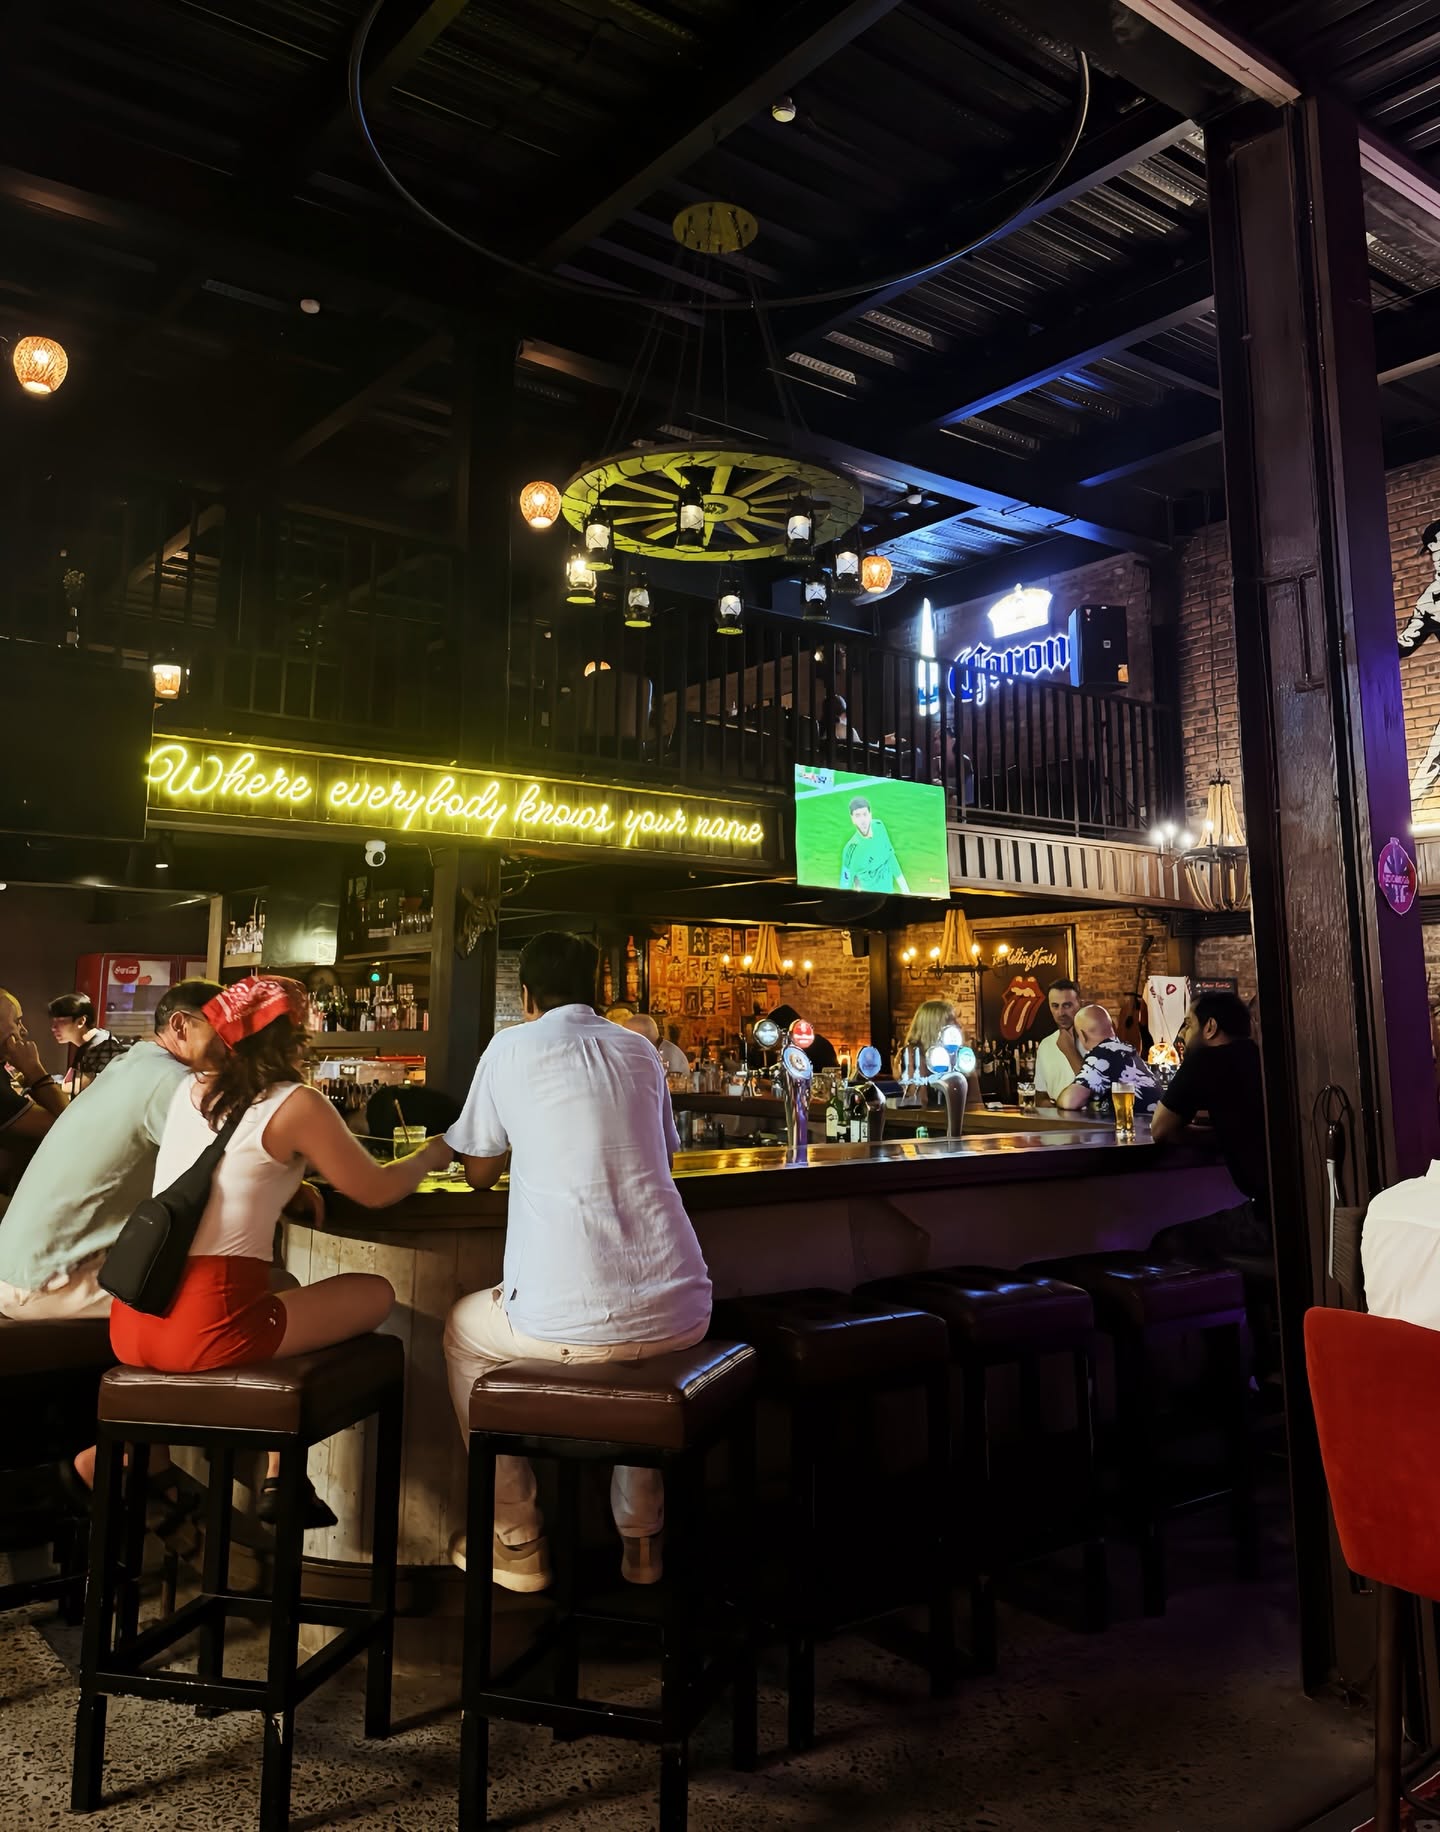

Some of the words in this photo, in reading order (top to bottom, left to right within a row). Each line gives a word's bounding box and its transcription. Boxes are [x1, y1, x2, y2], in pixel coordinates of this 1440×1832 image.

[948, 633, 1070, 705] Coron
[148, 744, 313, 801] Where
[330, 776, 507, 837] everybody
[514, 784, 615, 833] knows
[624, 807, 688, 848] your
[693, 815, 764, 843] name
